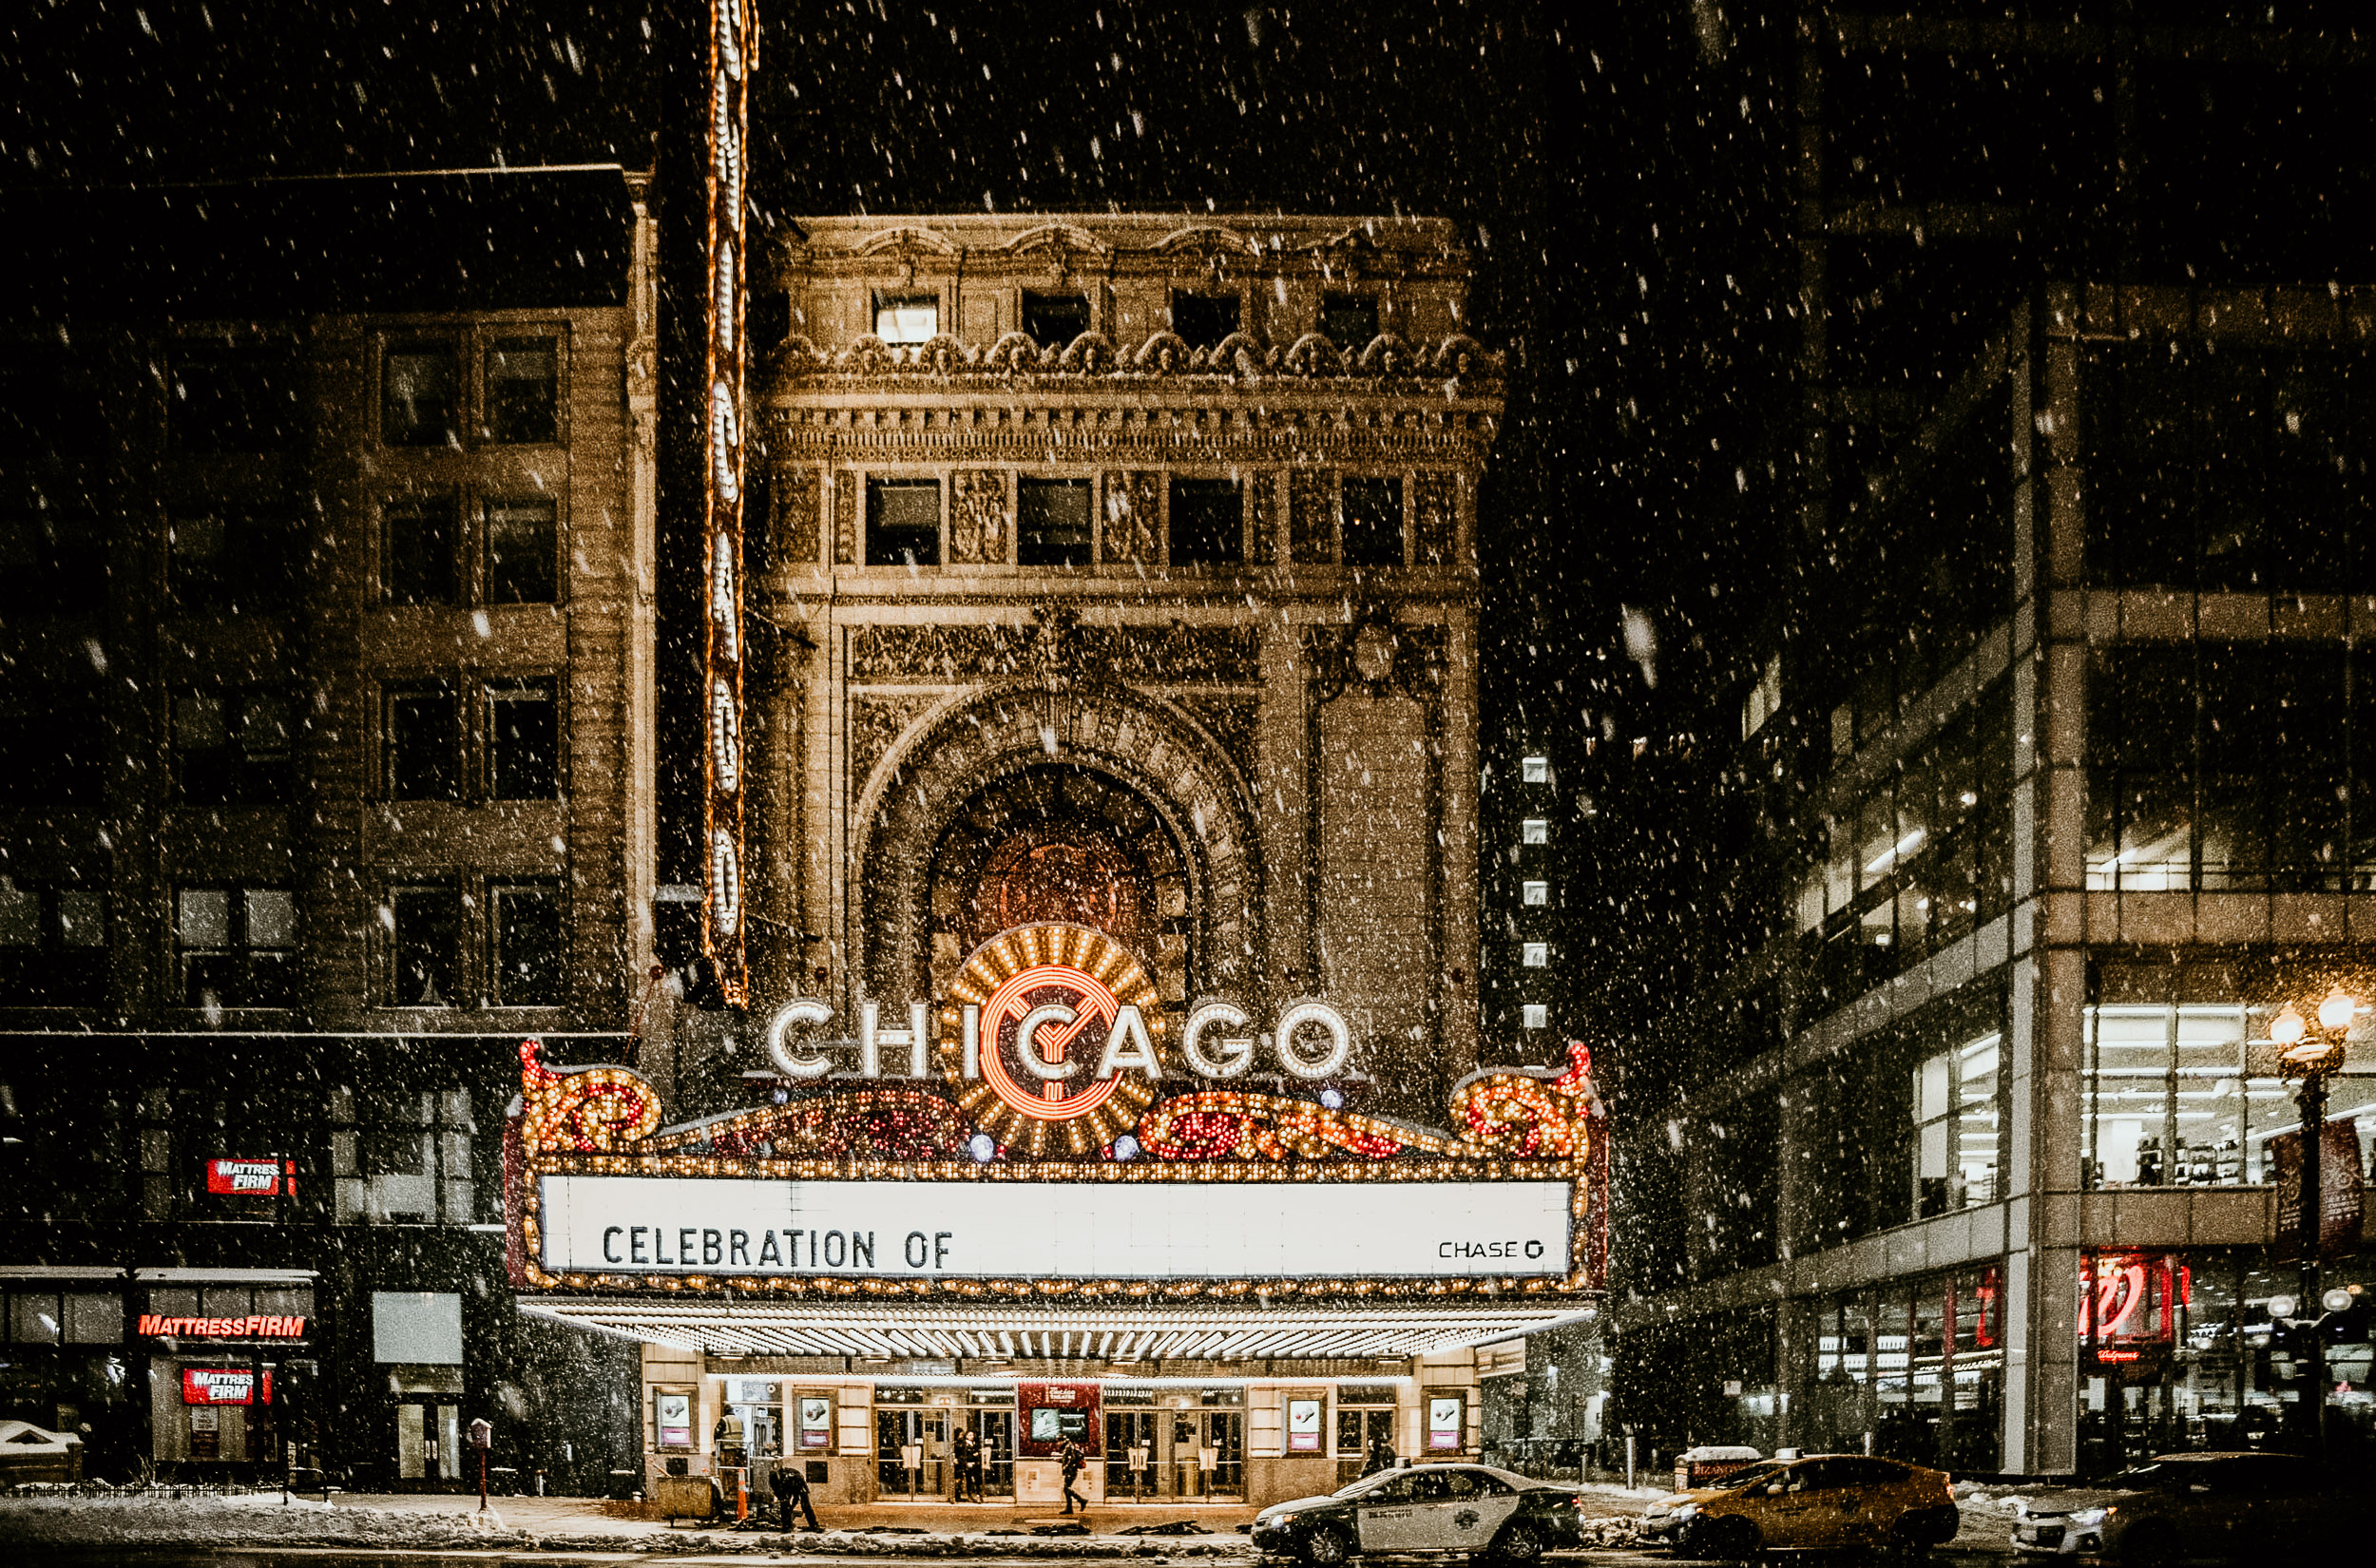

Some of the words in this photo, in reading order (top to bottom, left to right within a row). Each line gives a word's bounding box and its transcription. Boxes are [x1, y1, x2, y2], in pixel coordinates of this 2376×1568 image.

[766, 1001, 1351, 1081] CHICAGO
[217, 1161, 279, 1176] MATTRES
[233, 1174, 273, 1189] FIRM
[603, 1226, 875, 1269] CELEBRATION
[905, 1231, 953, 1270] OF
[1439, 1241, 1518, 1258] CHASE
[193, 1371, 255, 1386] MATTRES
[209, 1385, 249, 1398] FIRM
